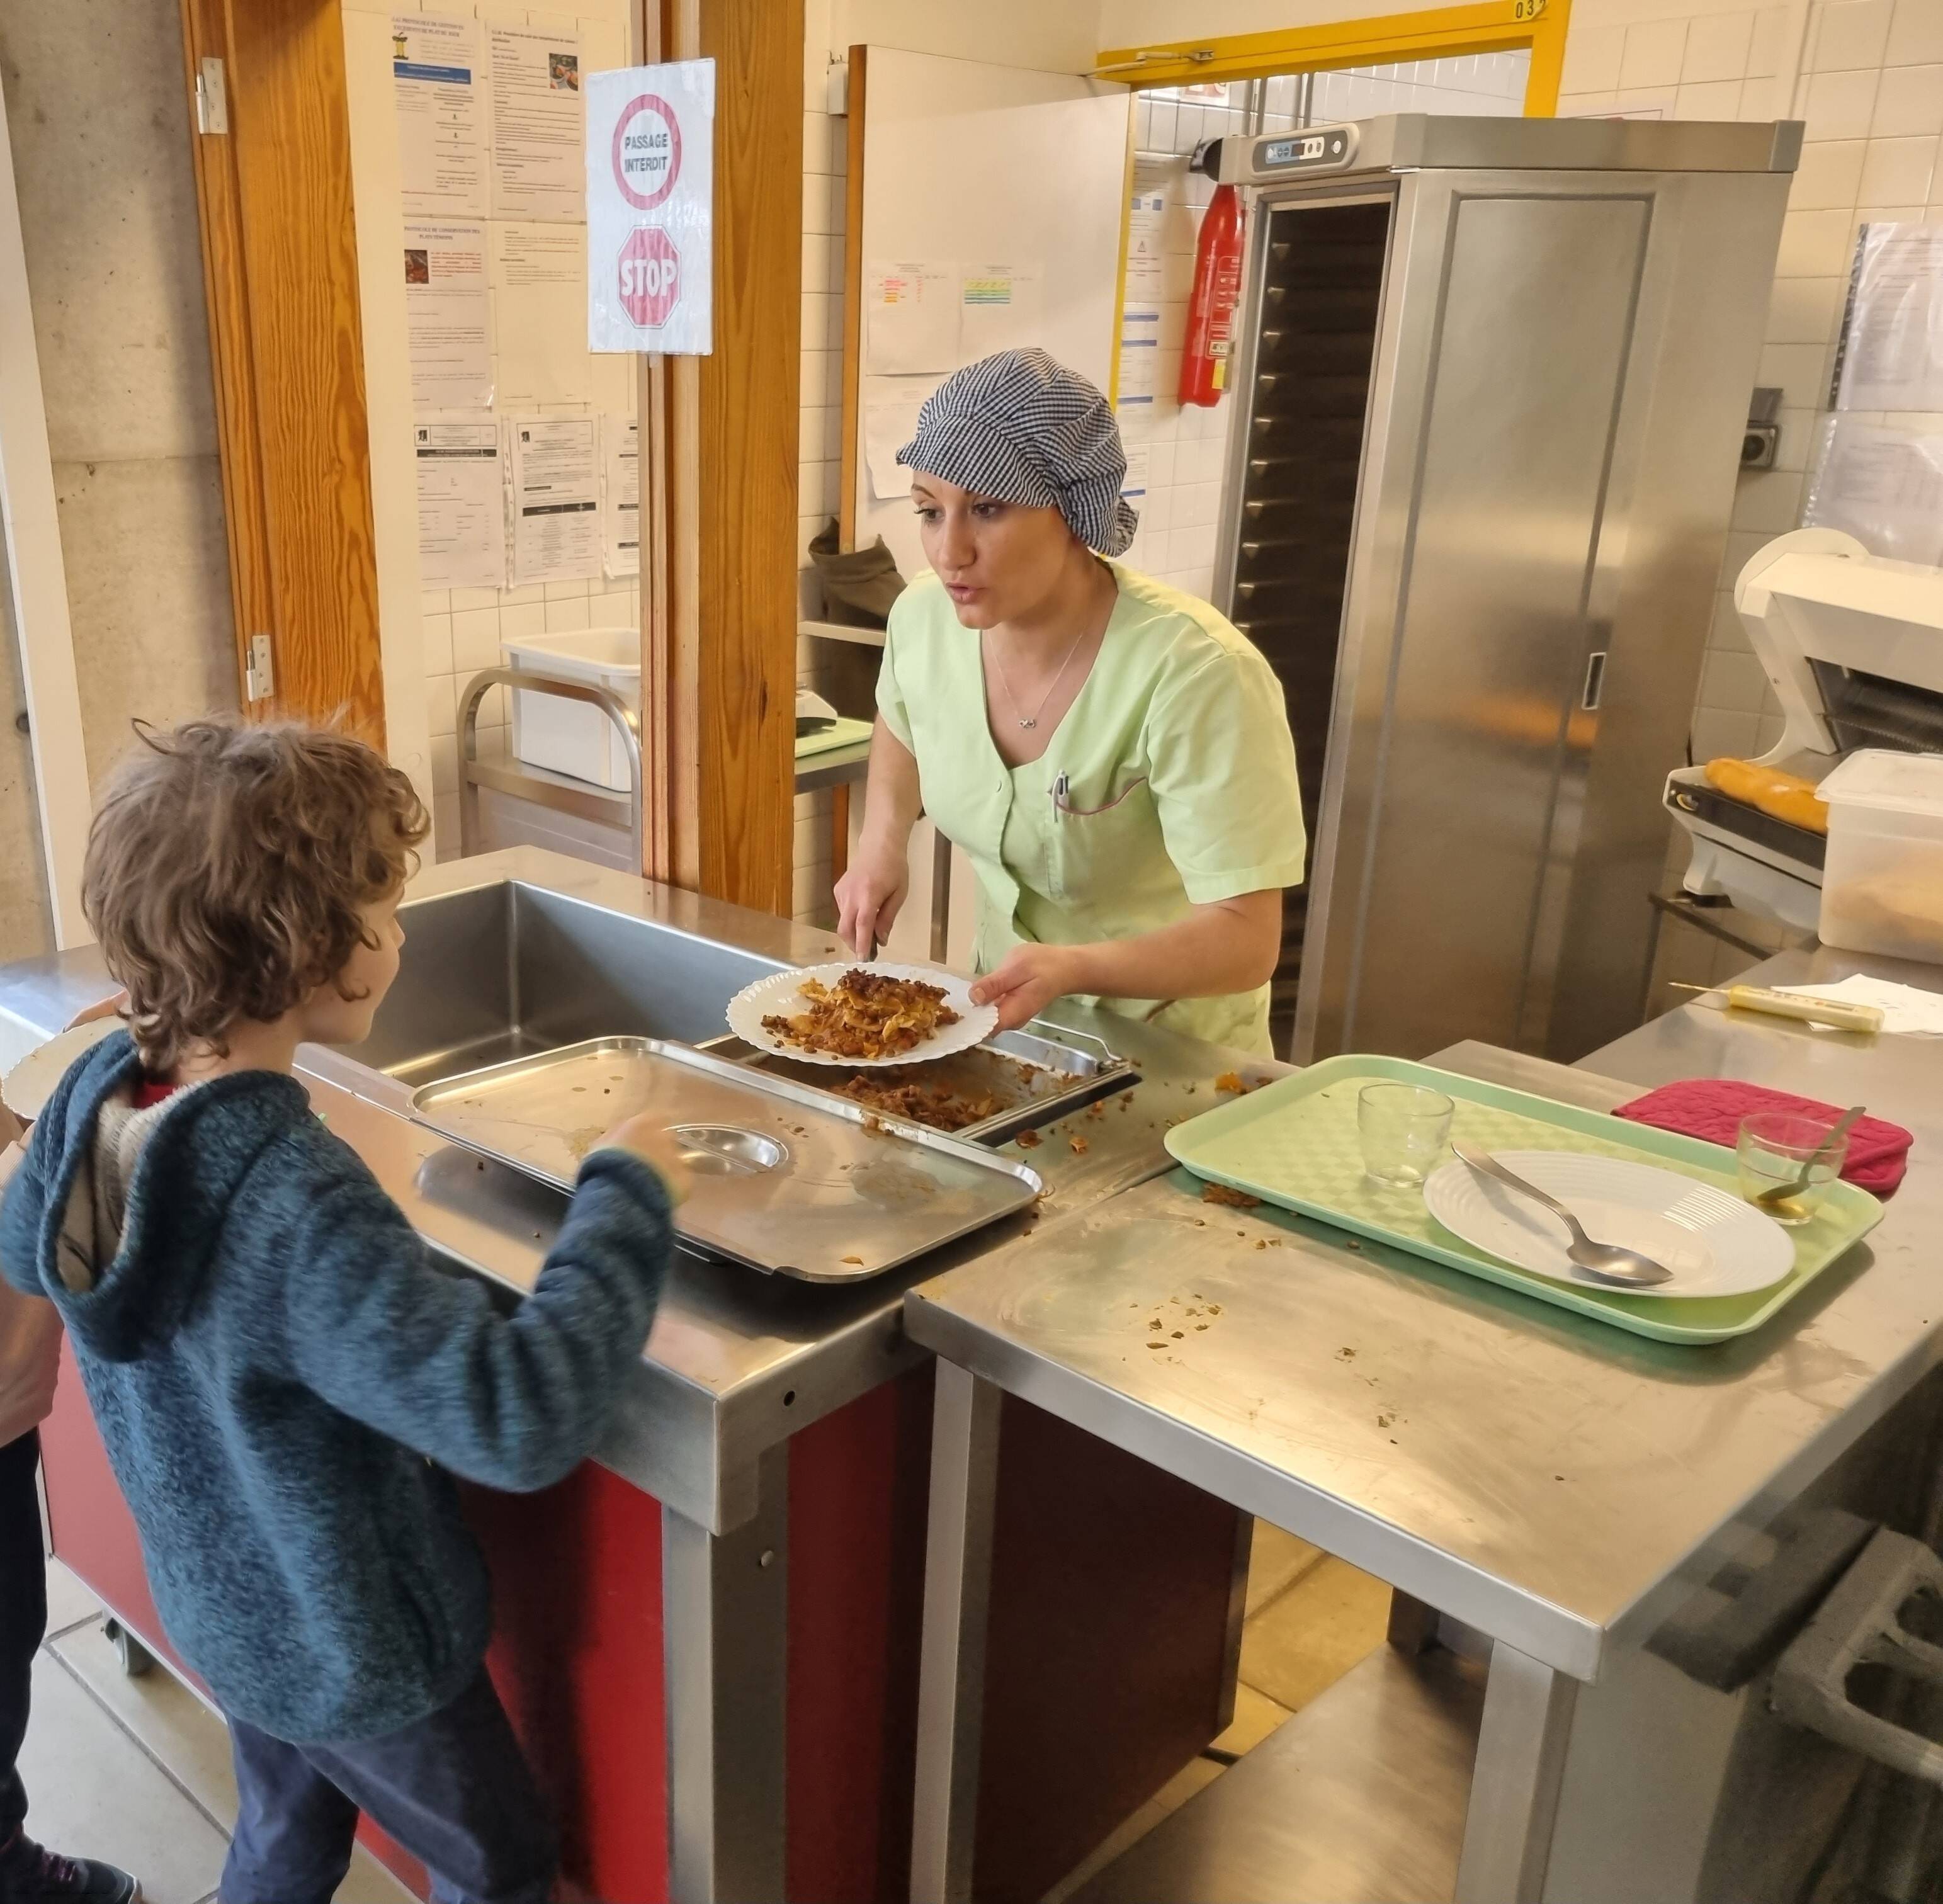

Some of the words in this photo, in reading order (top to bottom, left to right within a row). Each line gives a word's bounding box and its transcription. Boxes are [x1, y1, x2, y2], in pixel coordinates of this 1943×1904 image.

[625, 133, 668, 150] PASSAGE
[625, 156, 668, 173] INTERDIT
[621, 259, 678, 297] STOP
